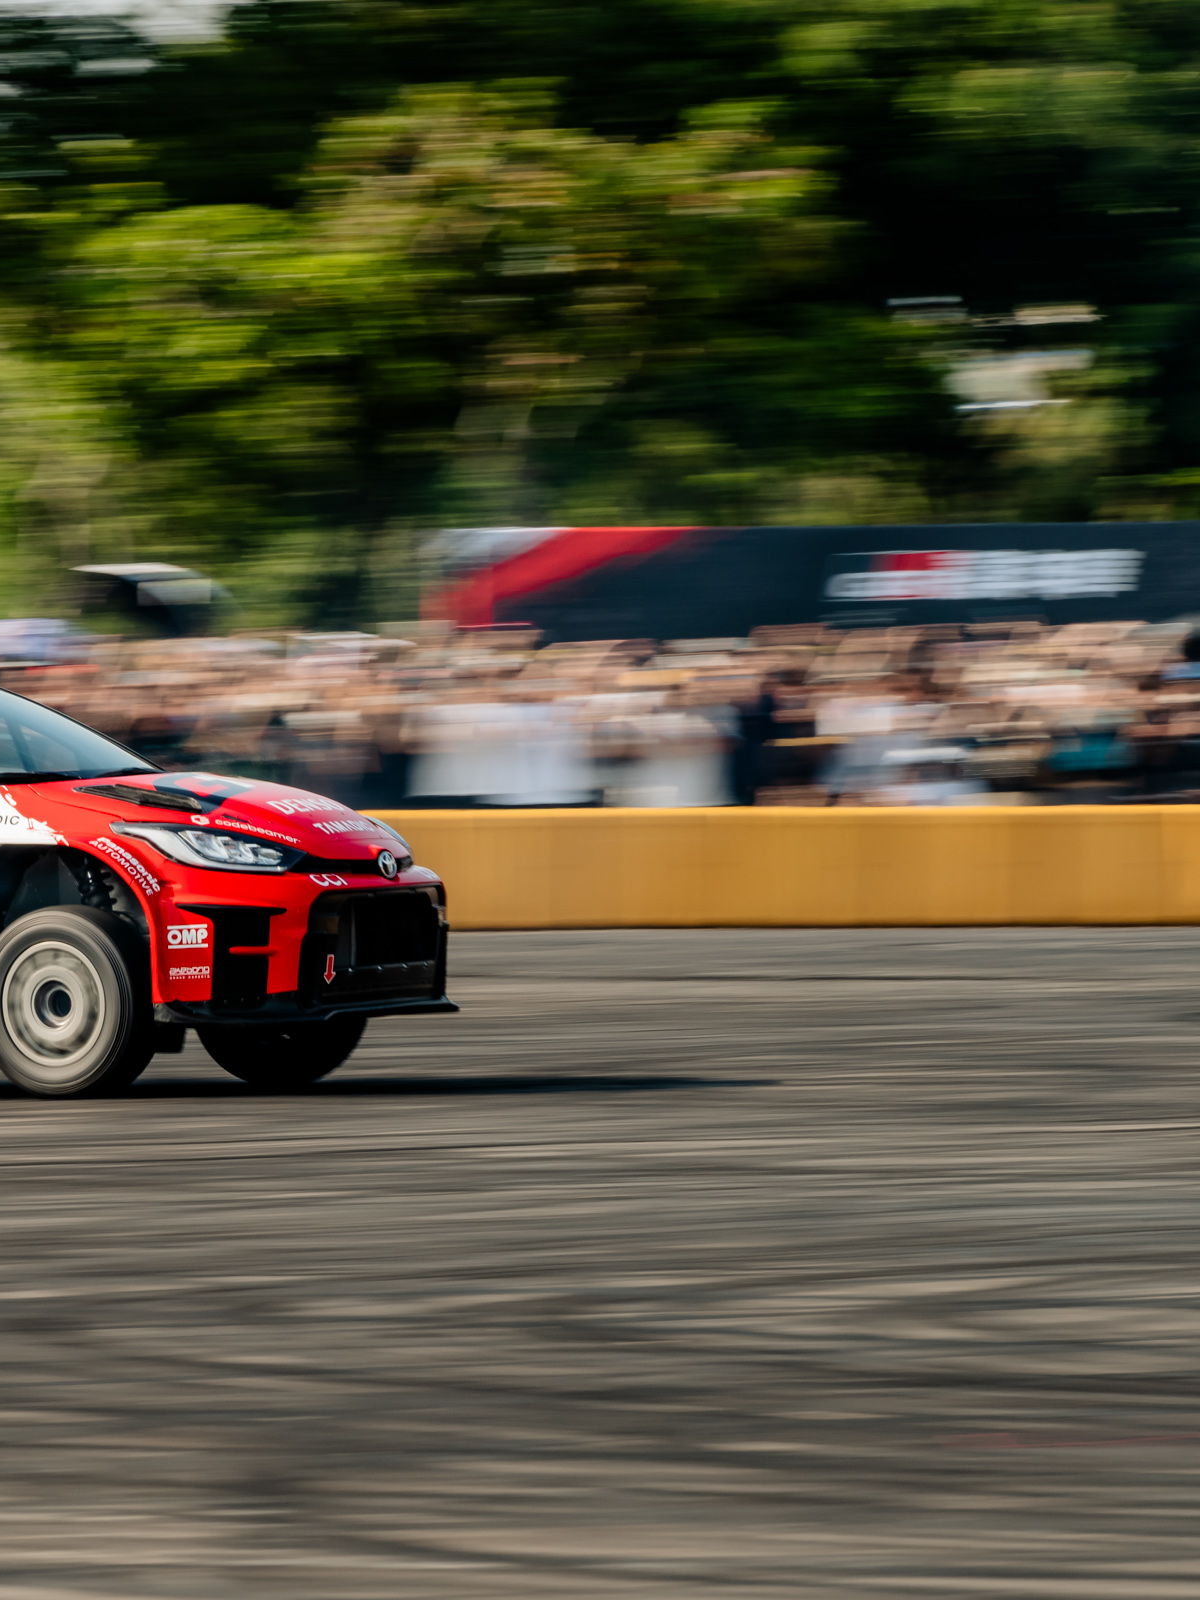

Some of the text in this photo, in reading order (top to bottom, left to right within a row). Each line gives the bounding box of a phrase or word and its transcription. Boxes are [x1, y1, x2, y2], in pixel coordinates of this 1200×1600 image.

[266, 797, 346, 815] DENSO
[215, 819, 301, 844] codebeamer
[89, 840, 153, 897] AUTOMOTIVE
[96, 837, 161, 893] Panasonic
[167, 928, 208, 945] OMP
